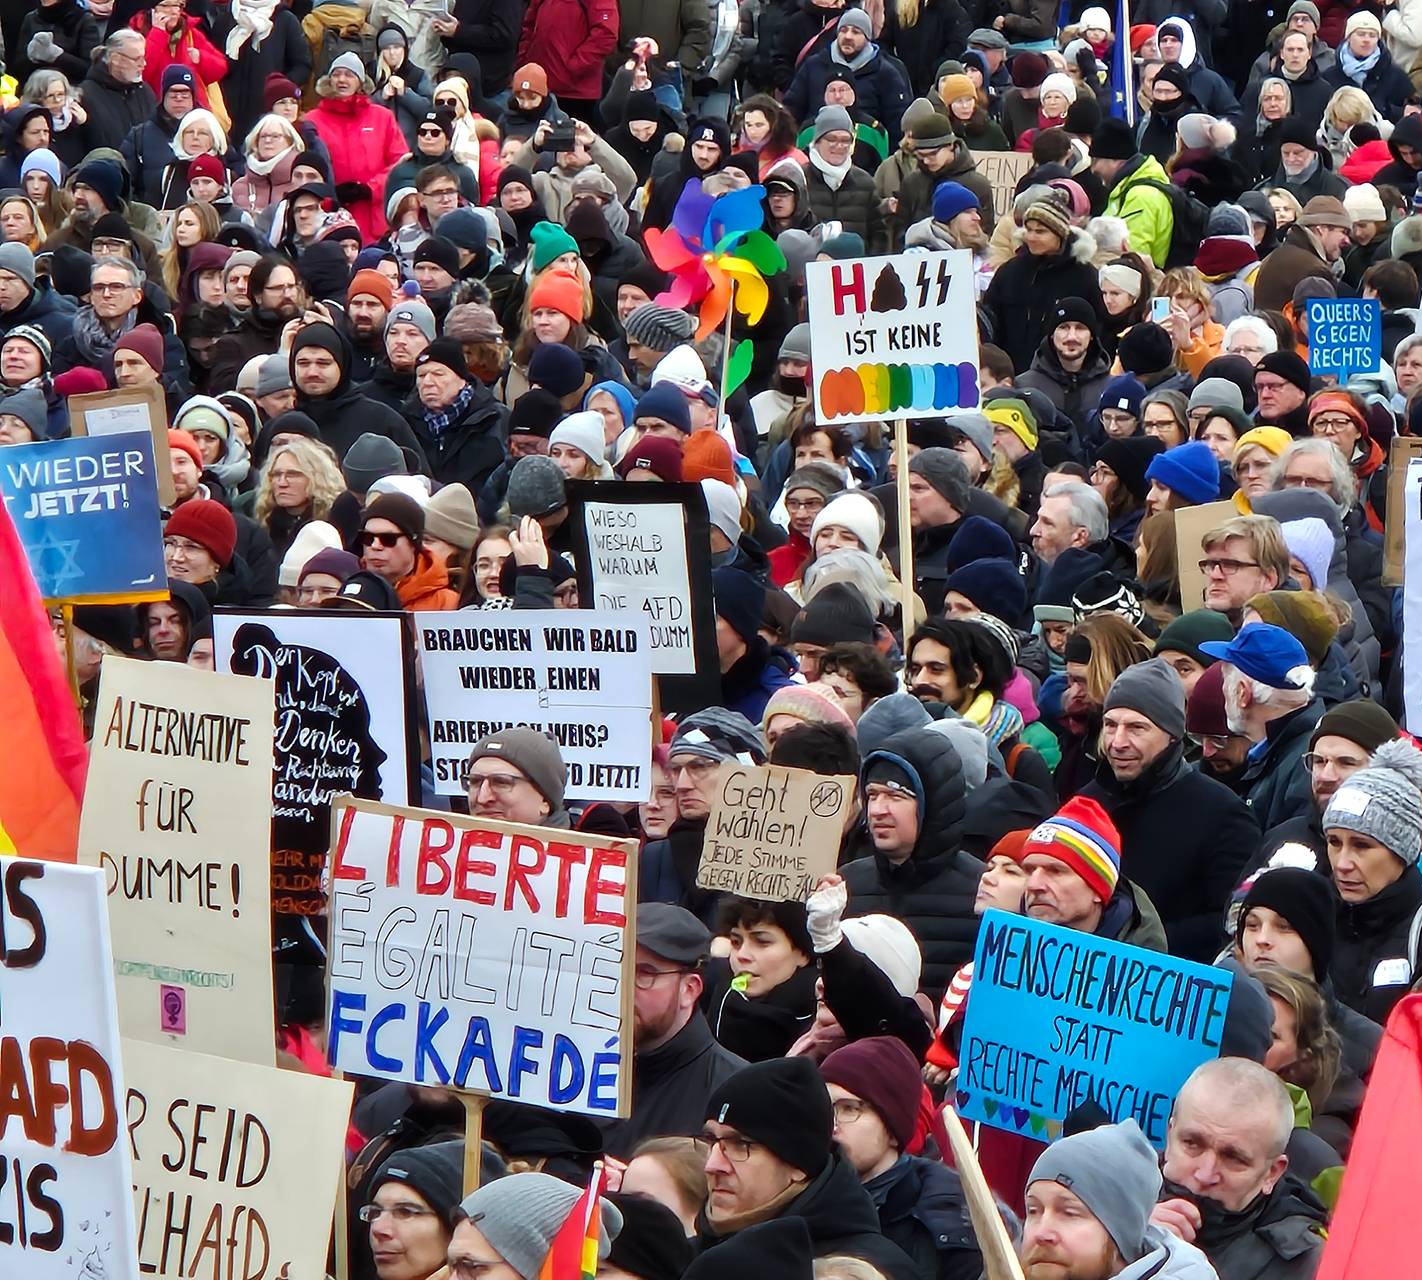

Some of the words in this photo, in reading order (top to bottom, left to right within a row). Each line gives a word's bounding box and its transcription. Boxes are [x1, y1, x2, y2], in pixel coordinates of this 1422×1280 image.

[1311, 303, 1373, 324] QUEERS
[845, 330, 877, 356] IST
[888, 322, 942, 351] KEINE
[1315, 325, 1372, 345] GEGEN
[1312, 346, 1372, 369] RECHTS
[7, 450, 145, 489] WIEDER
[24, 483, 130, 519] JETZT!
[590, 509, 637, 528] WIESO
[593, 534, 663, 552] WESHALB
[599, 557, 659, 576] WARUM
[423, 628, 532, 651] BRAUCHEN
[543, 628, 585, 651] WIR
[590, 629, 638, 652] BALD
[649, 625, 690, 649] DUMM
[458, 667, 536, 690] WIEDER
[546, 667, 601, 691] EINEN
[104, 695, 251, 767] ALTERNATIVE
[275, 709, 361, 764] Denken
[588, 764, 641, 789] JETZT!
[723, 770, 790, 813] Geht
[704, 840, 744, 864] JEDE
[749, 847, 808, 871] STIMME
[99, 850, 240, 918] DUMME!
[698, 864, 745, 890] GEGEN
[745, 869, 791, 898] RECHTS
[792, 872, 821, 901] ZÄH
[331, 881, 624, 1032] ÉGALITÉ
[978, 920, 1230, 1048] MENSCHENRECHTE
[328, 988, 622, 1111] FCKAFDÉ
[1049, 1015, 1123, 1065] STATT
[0, 1036, 118, 1157] AFD
[966, 1037, 1050, 1109] RECHTE
[1053, 1064, 1178, 1142] MENSCHE
[161, 1097, 271, 1188] SEID
[131, 1184, 269, 1280] LHAfD
